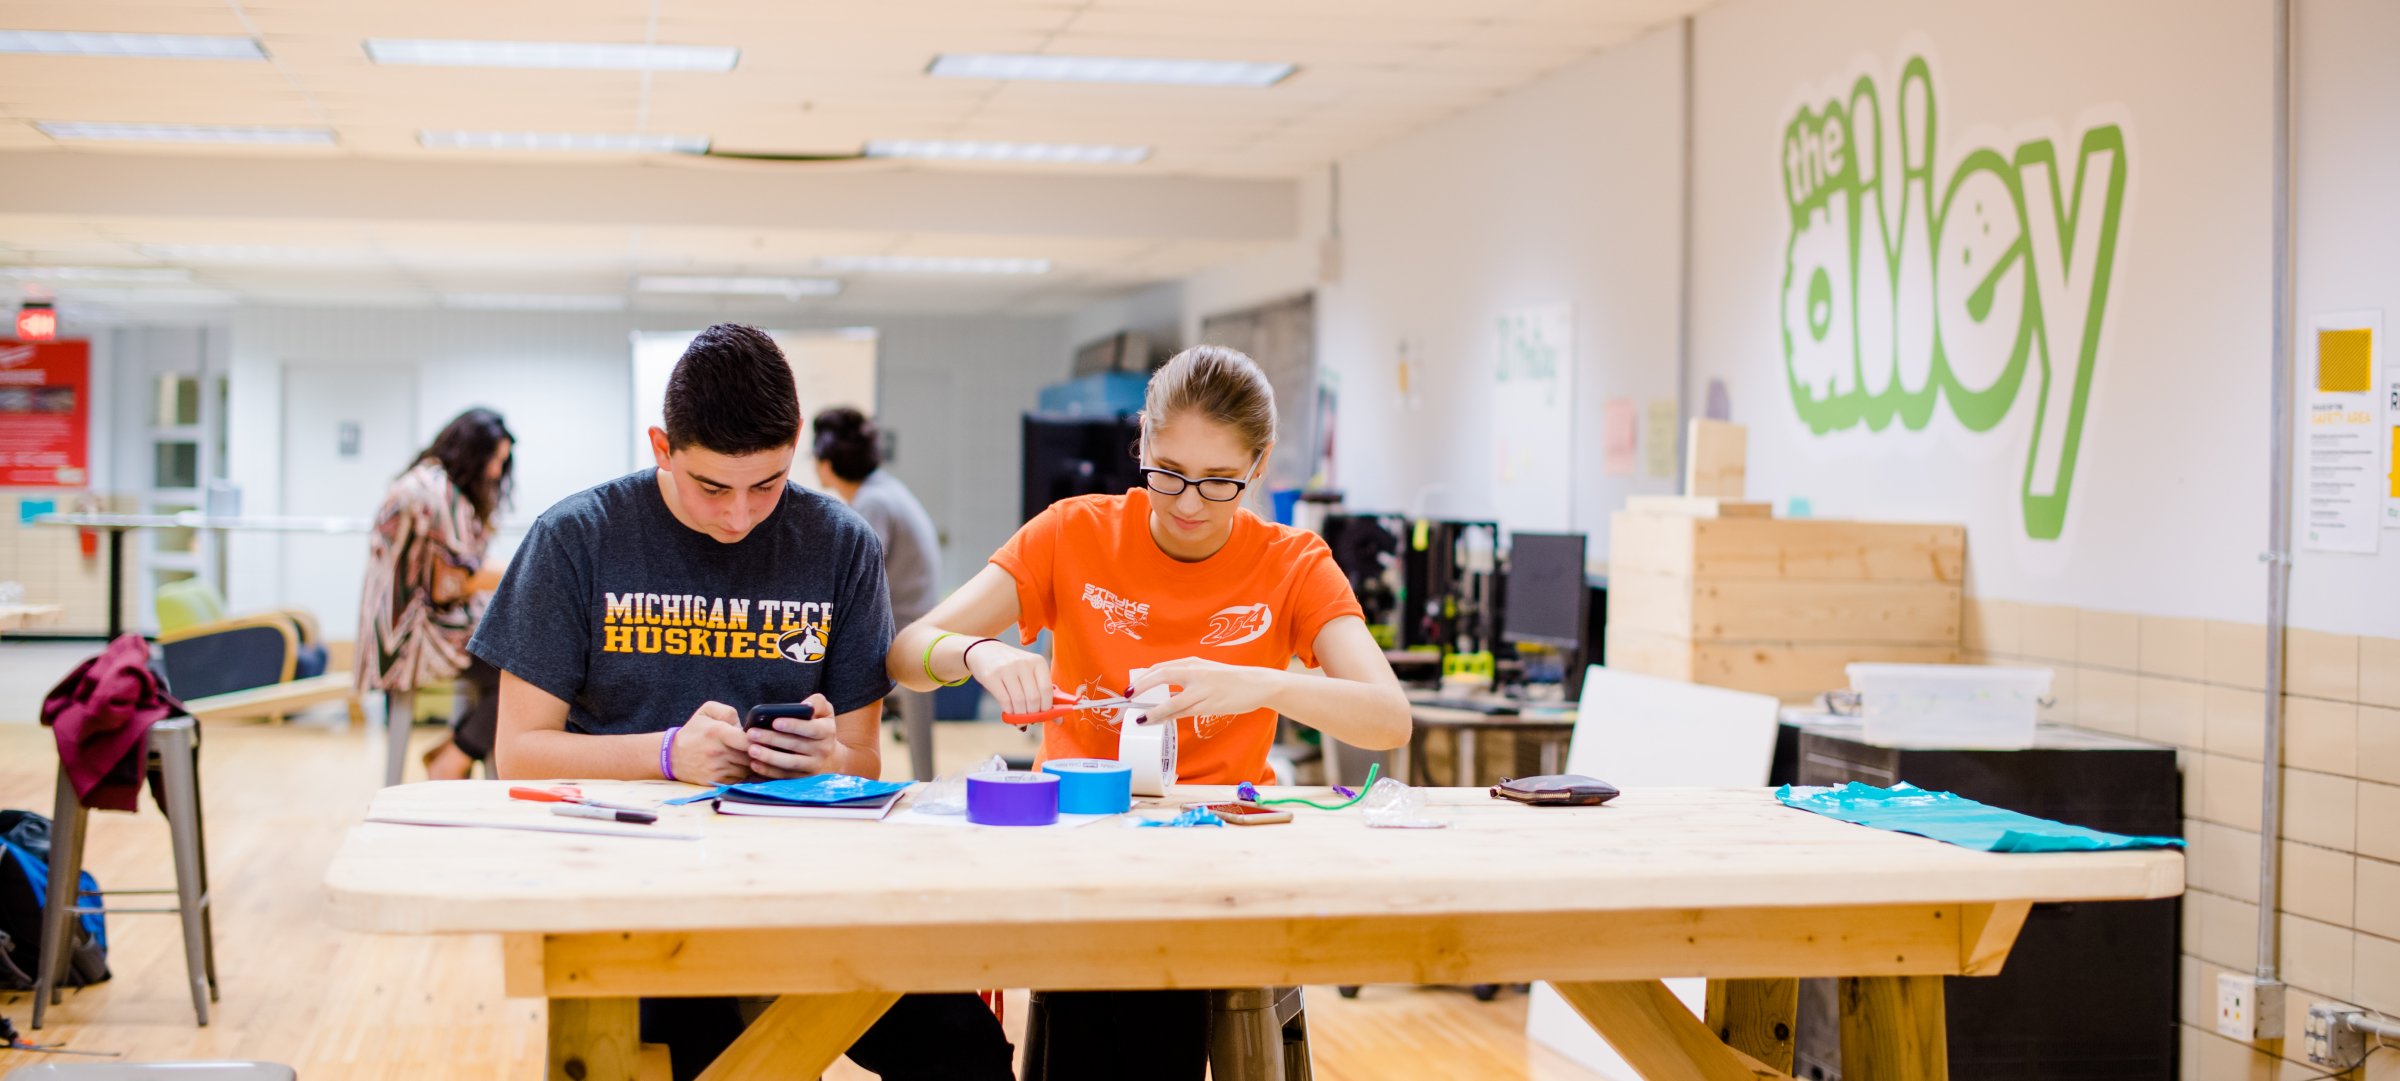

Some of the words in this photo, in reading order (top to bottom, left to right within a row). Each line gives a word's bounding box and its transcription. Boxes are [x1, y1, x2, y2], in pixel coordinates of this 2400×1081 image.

[1785, 108, 1848, 206] the
[1783, 55, 2127, 541] alley
[604, 592, 750, 630] MICHIGAN
[1084, 583, 1150, 615] STRYKE
[603, 625, 783, 659] HUSKIES
